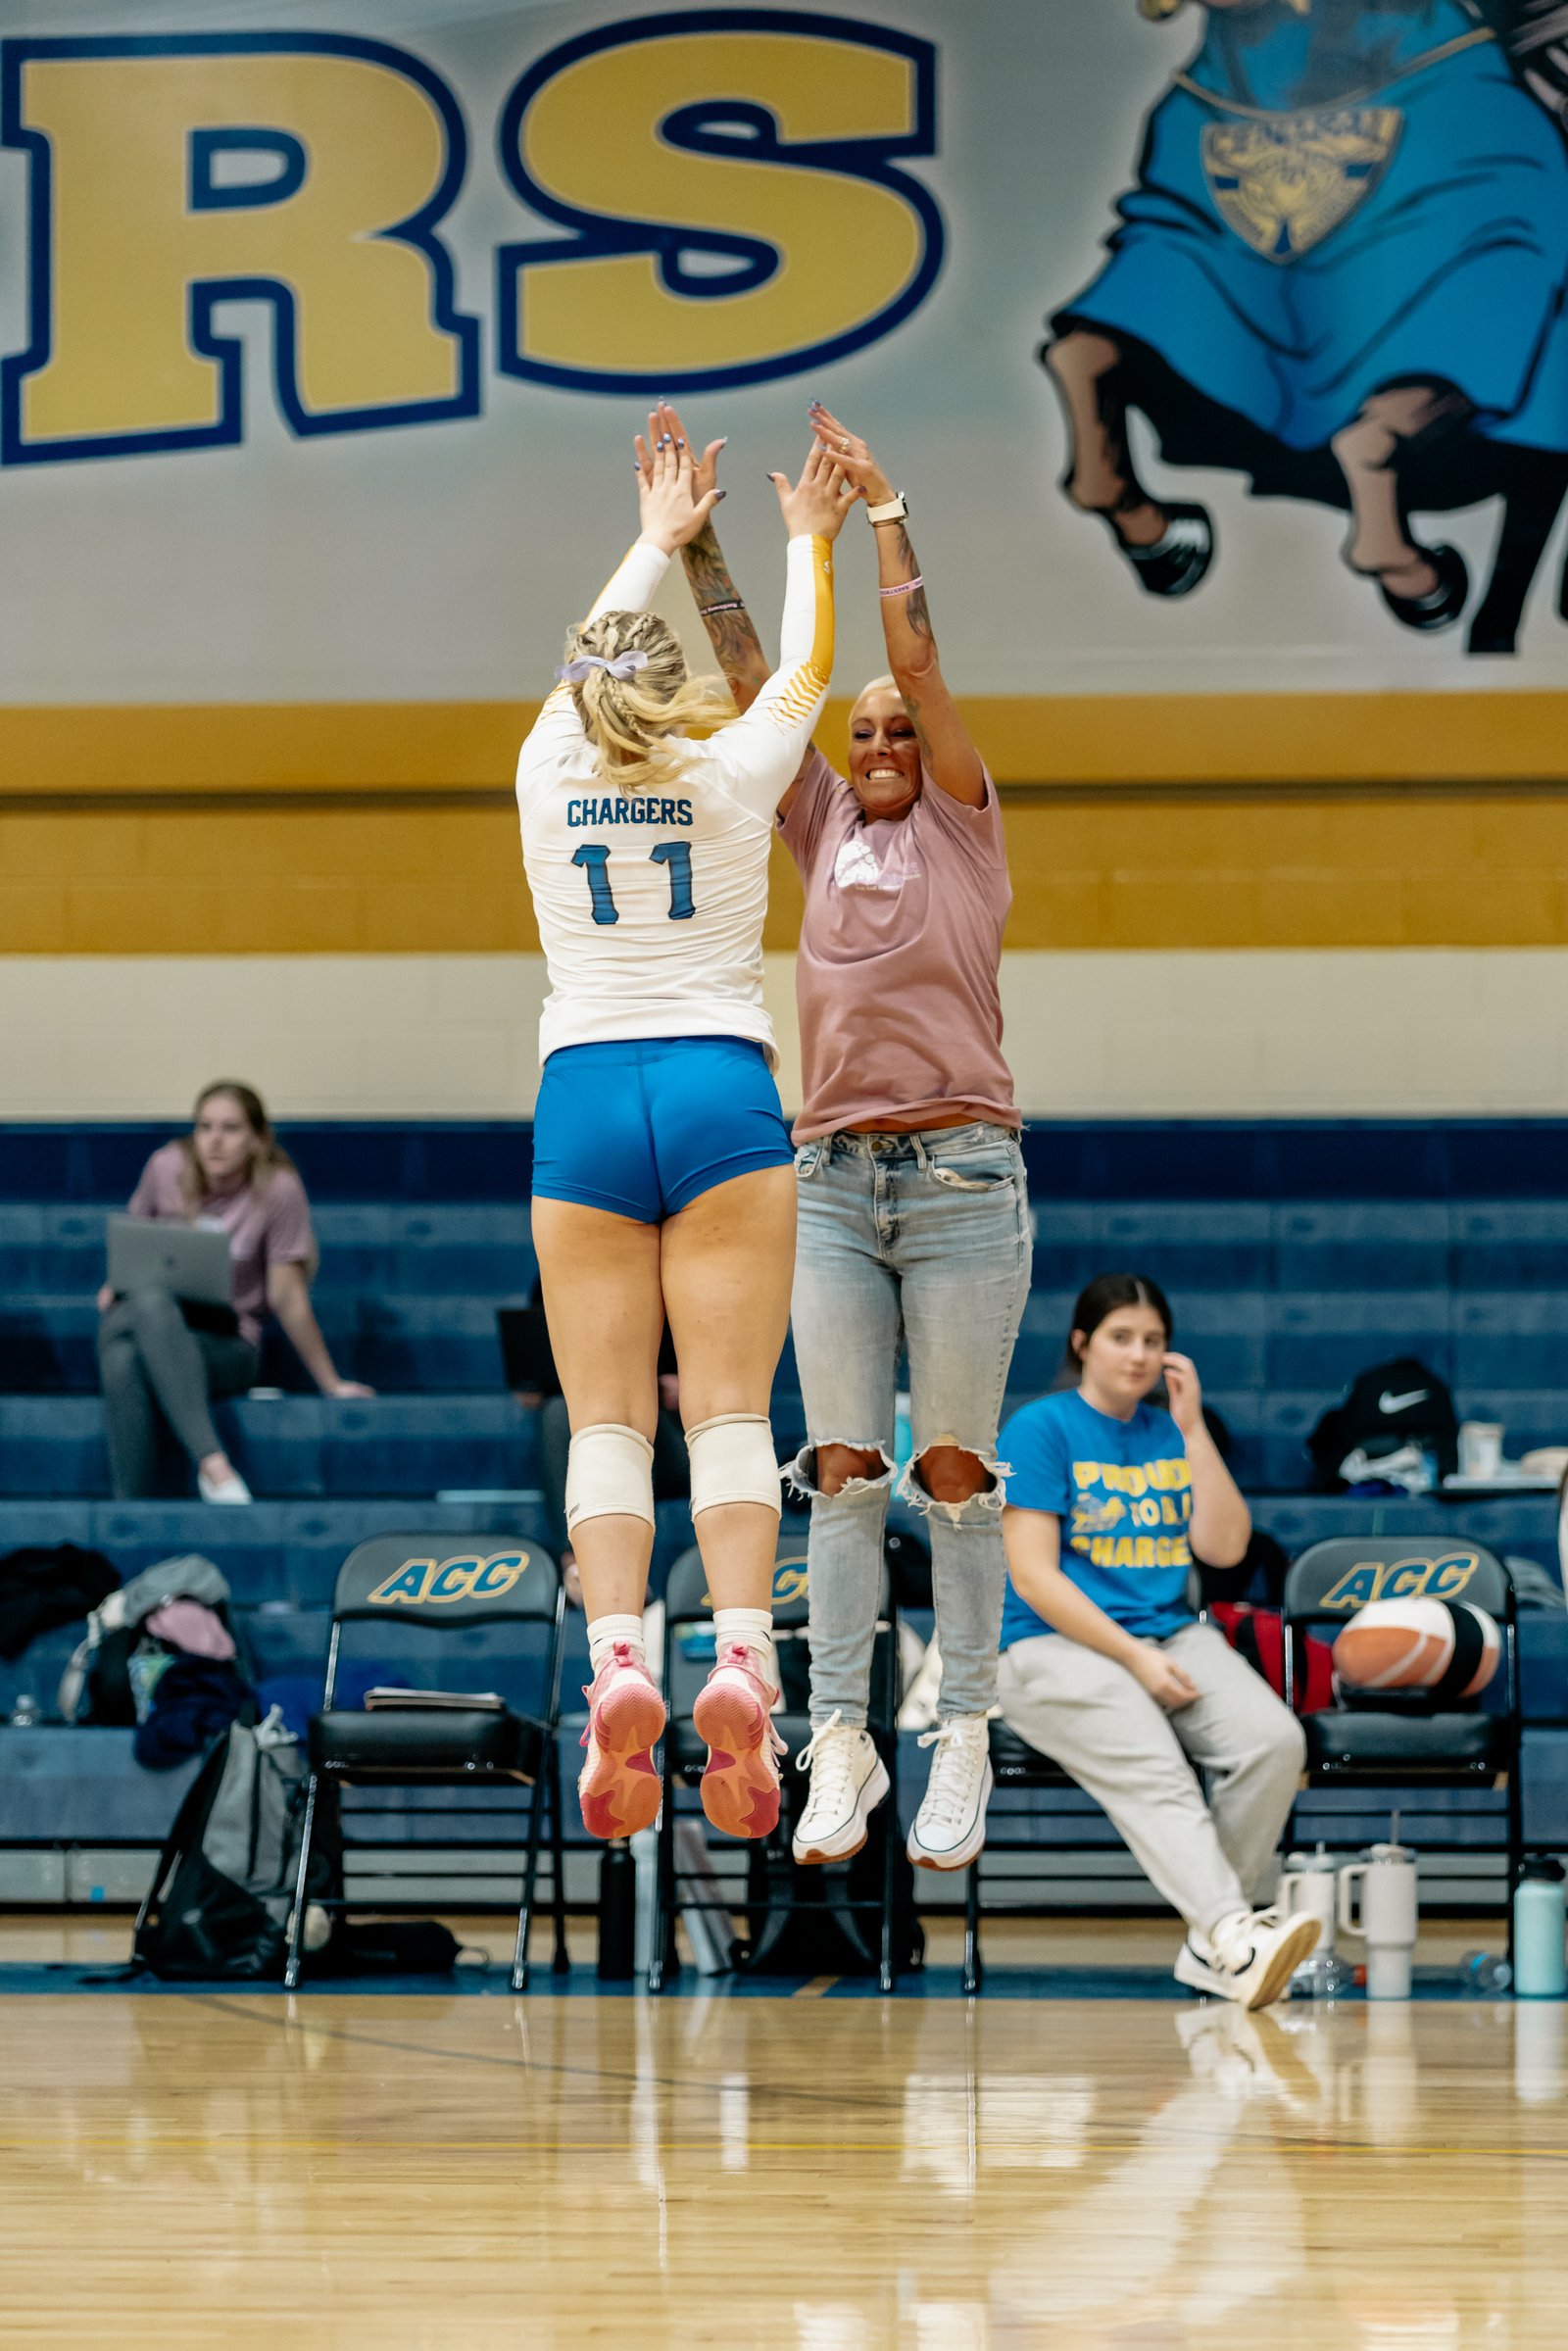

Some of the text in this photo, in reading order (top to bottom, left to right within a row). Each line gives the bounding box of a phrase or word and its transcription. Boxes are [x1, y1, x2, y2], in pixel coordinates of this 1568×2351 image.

[0, 8, 946, 469] RS
[567, 797, 694, 827] CHARGERS
[570, 841, 697, 925] 11
[1072, 1458, 1192, 1497] PROUD
[367, 1550, 530, 1605] ACC
[1319, 1551, 1480, 1608] ACC
